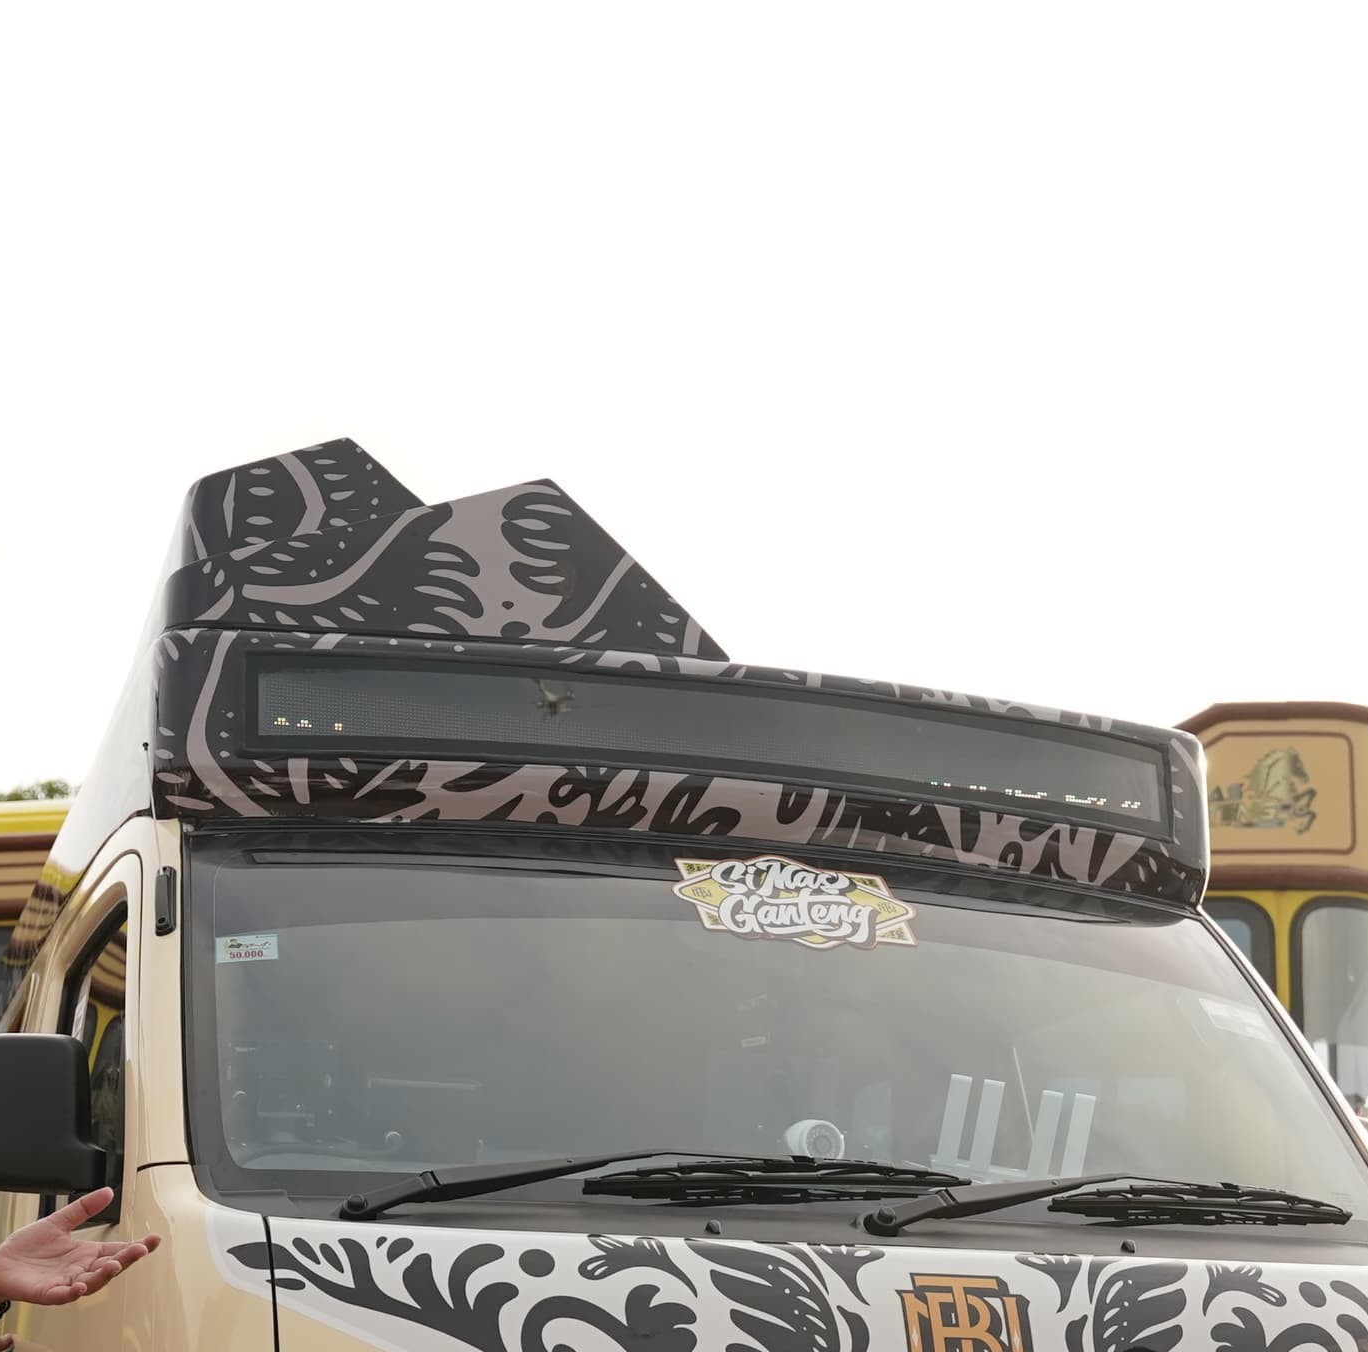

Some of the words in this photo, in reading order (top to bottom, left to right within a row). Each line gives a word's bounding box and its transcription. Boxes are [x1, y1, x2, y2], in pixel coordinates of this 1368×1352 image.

[711, 861, 759, 894] Si
[753, 861, 850, 896] Mas
[718, 887, 874, 944] Ganteng
